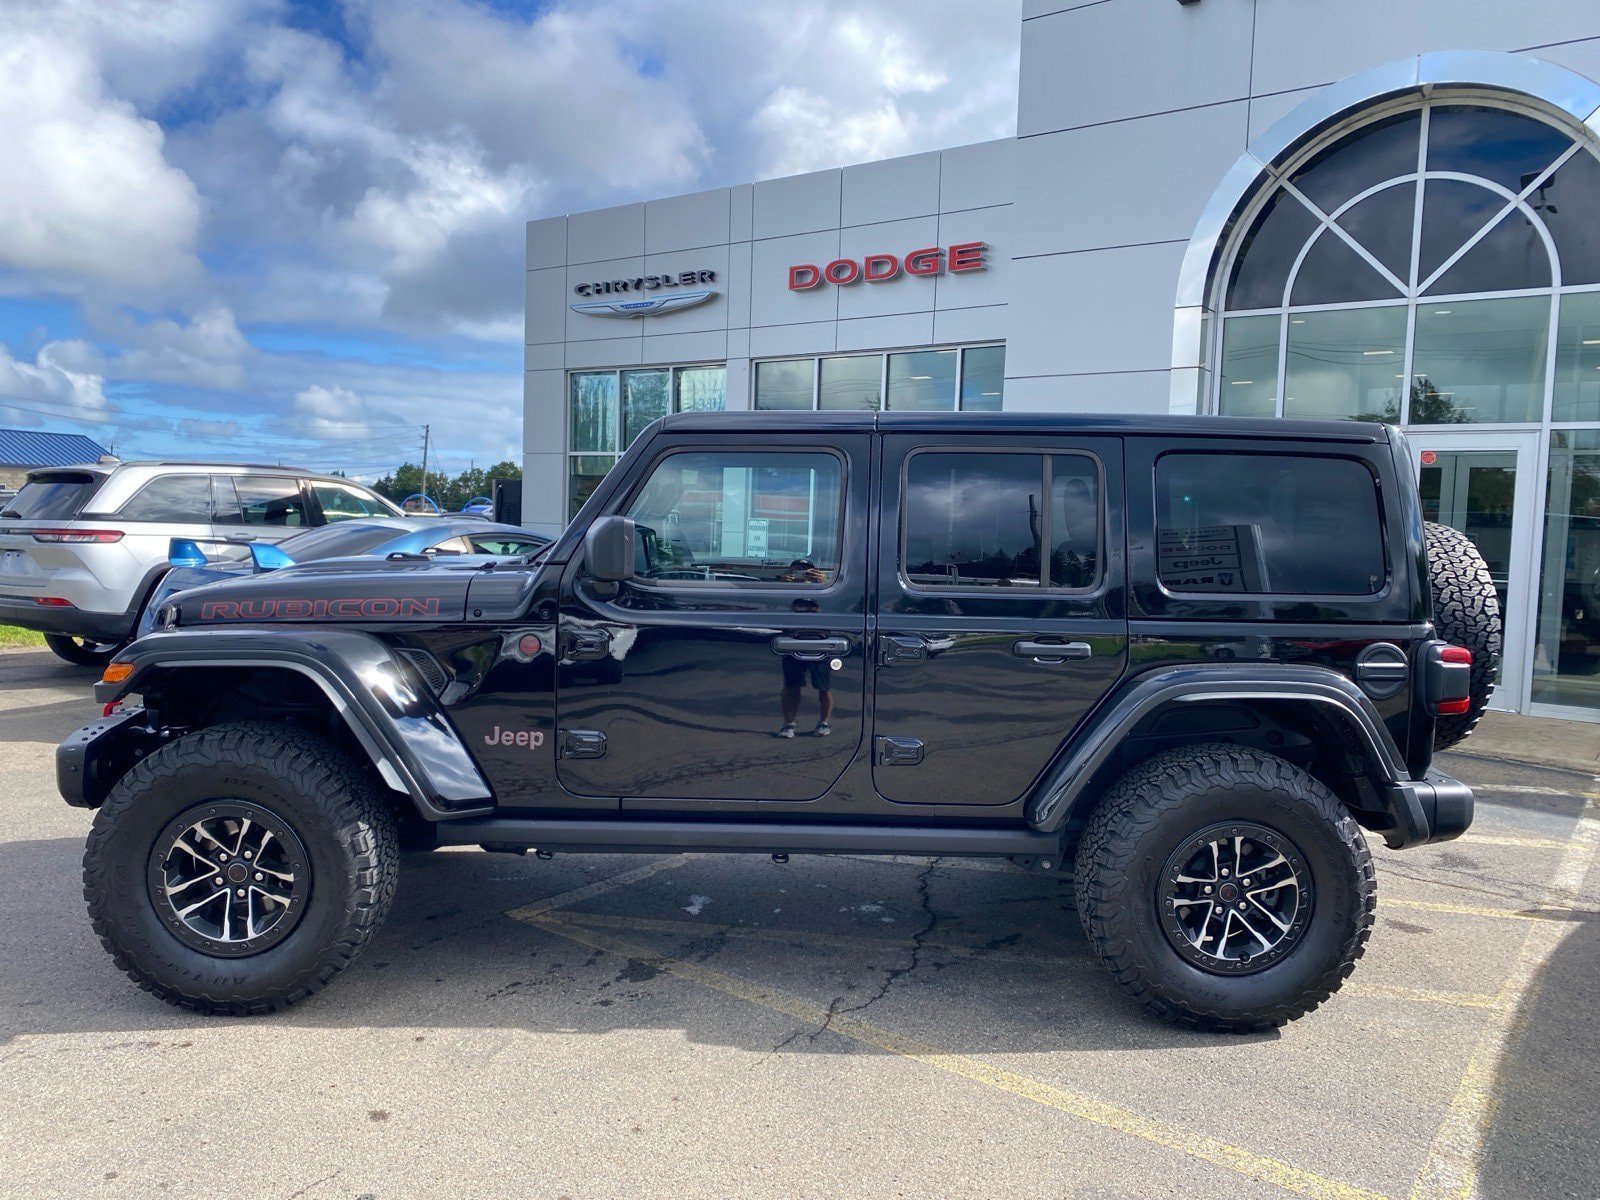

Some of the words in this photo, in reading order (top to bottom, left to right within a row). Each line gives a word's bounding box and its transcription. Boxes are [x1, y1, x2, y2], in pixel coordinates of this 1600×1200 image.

[788, 241, 988, 292] DODGE
[574, 269, 716, 296] CHRYSLER
[201, 598, 440, 620] RUBICON
[484, 726, 544, 750] Jeep
